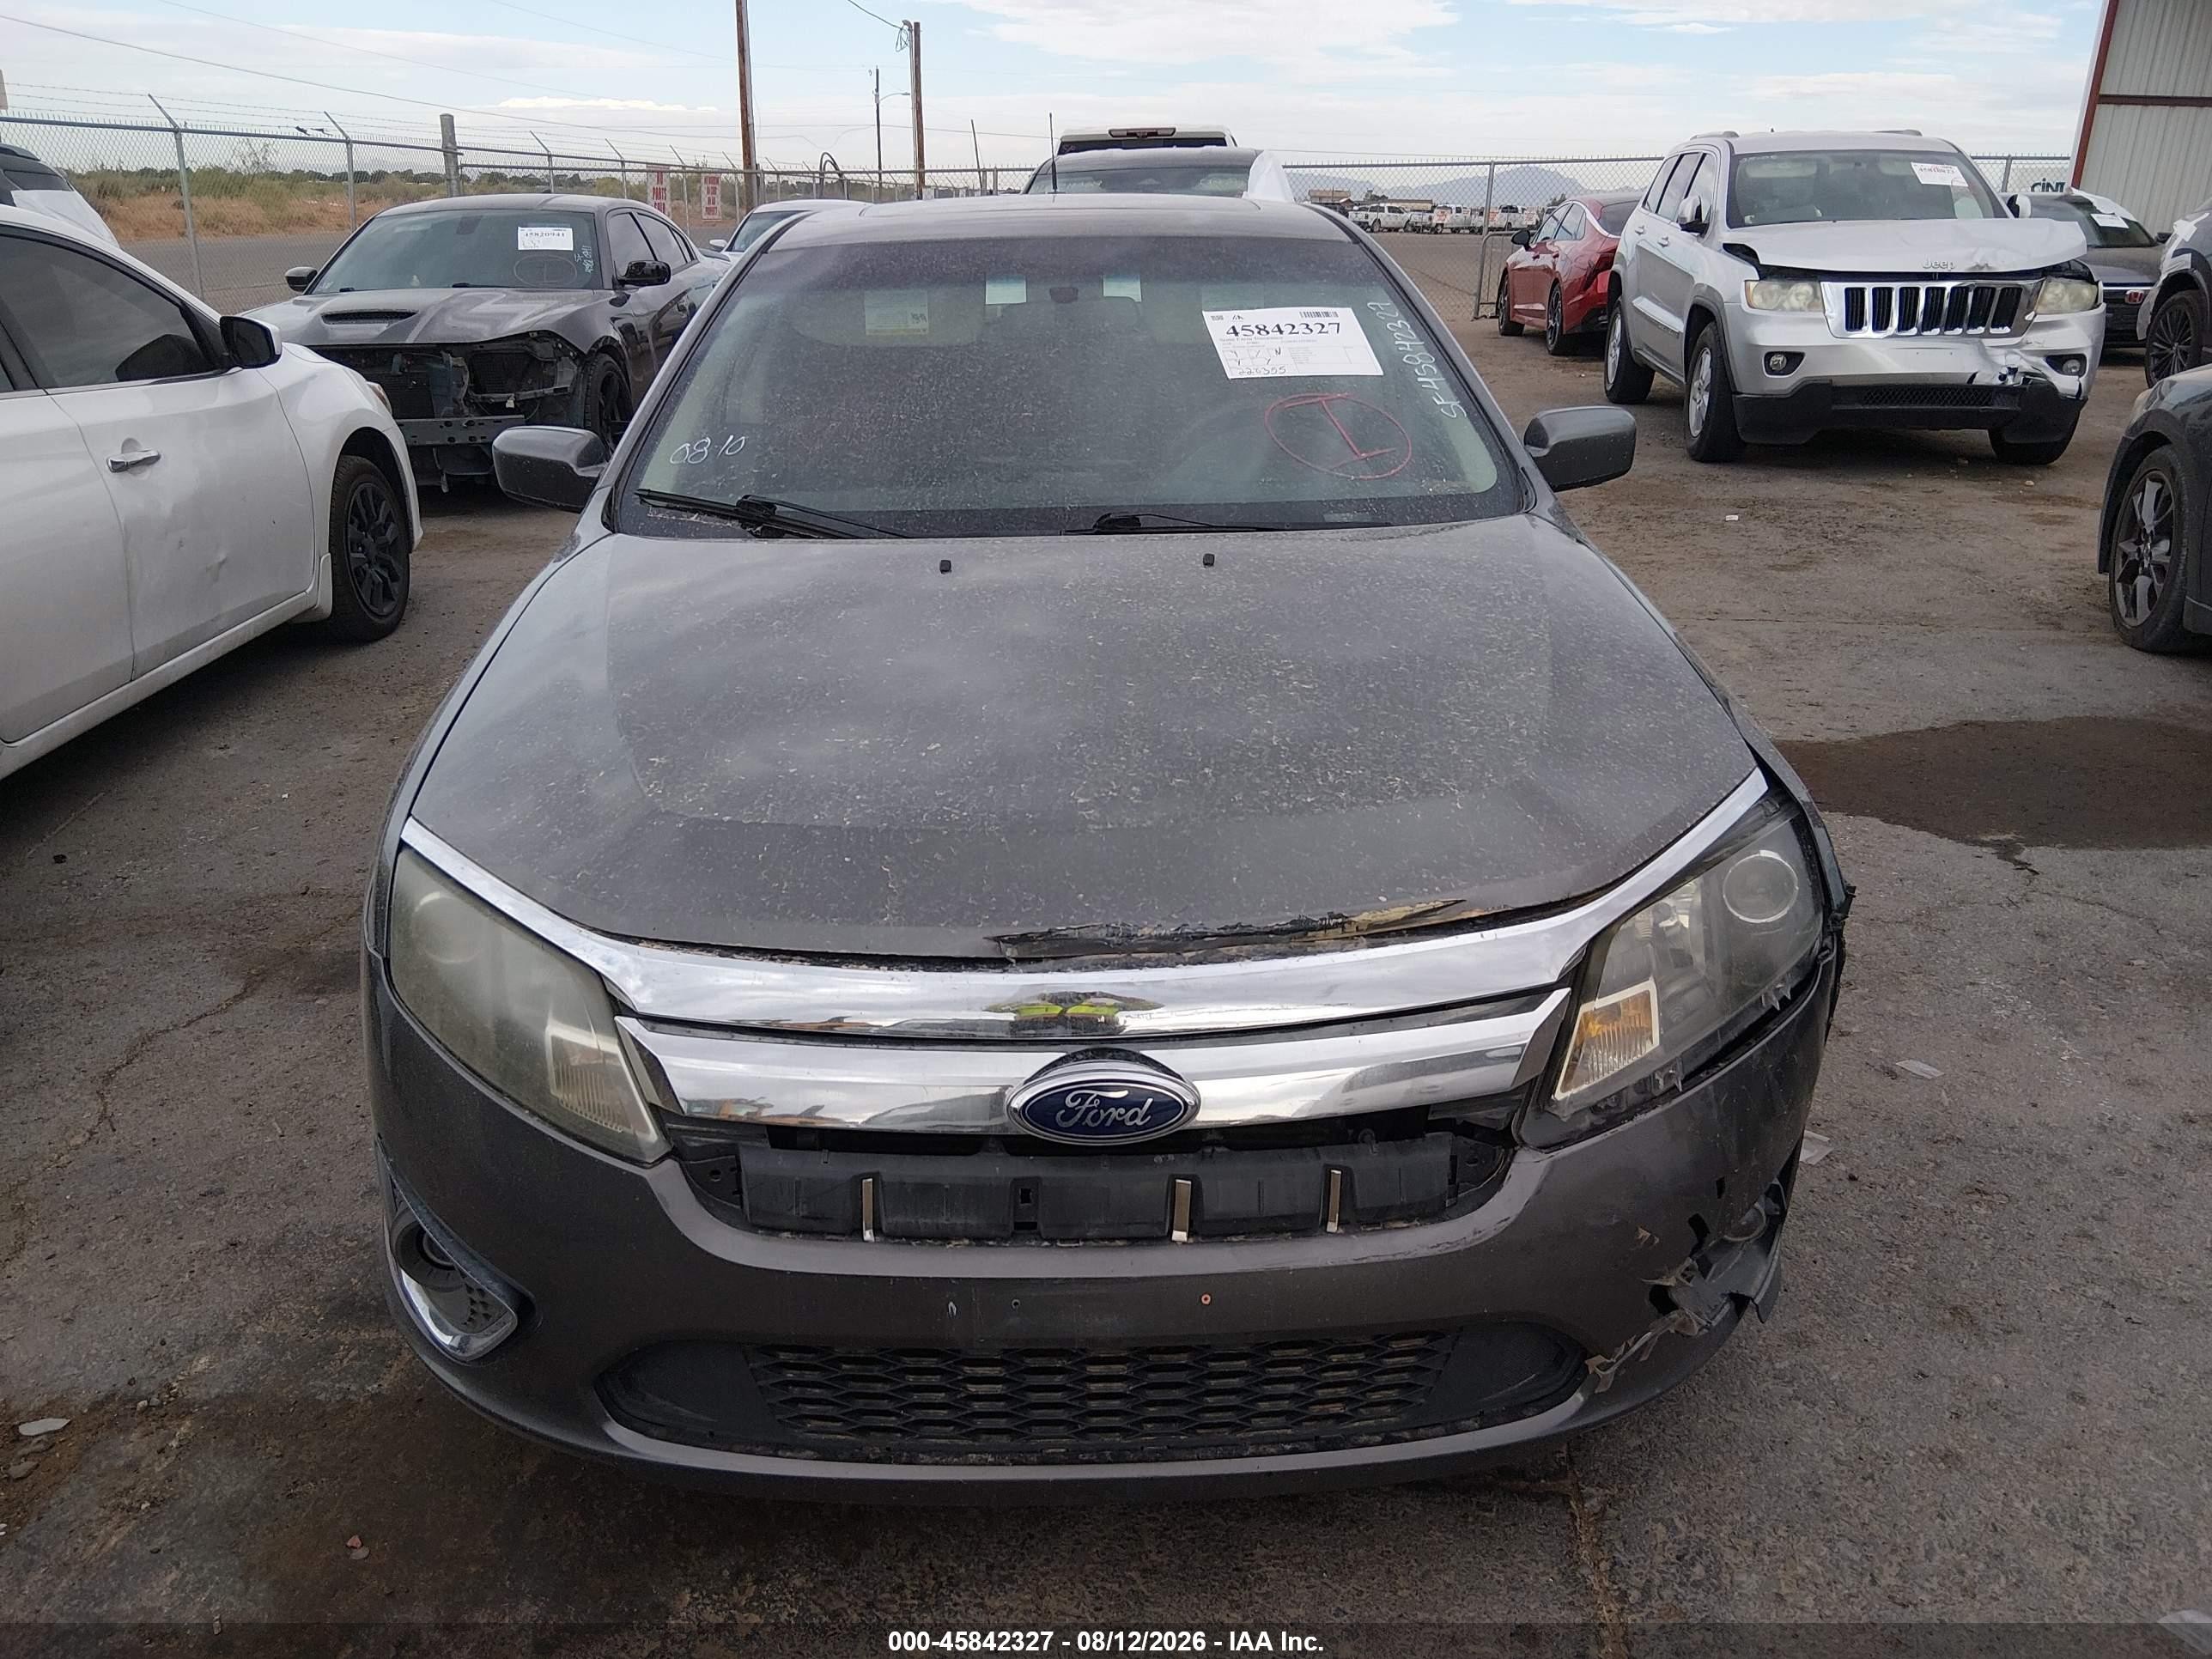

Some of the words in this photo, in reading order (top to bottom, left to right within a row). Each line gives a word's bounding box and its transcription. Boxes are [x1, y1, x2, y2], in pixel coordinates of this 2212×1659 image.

[1923, 254, 1955, 270] Jeep
[1225, 322, 1340, 337] 45842327
[1055, 1089, 1155, 1128] Ford
